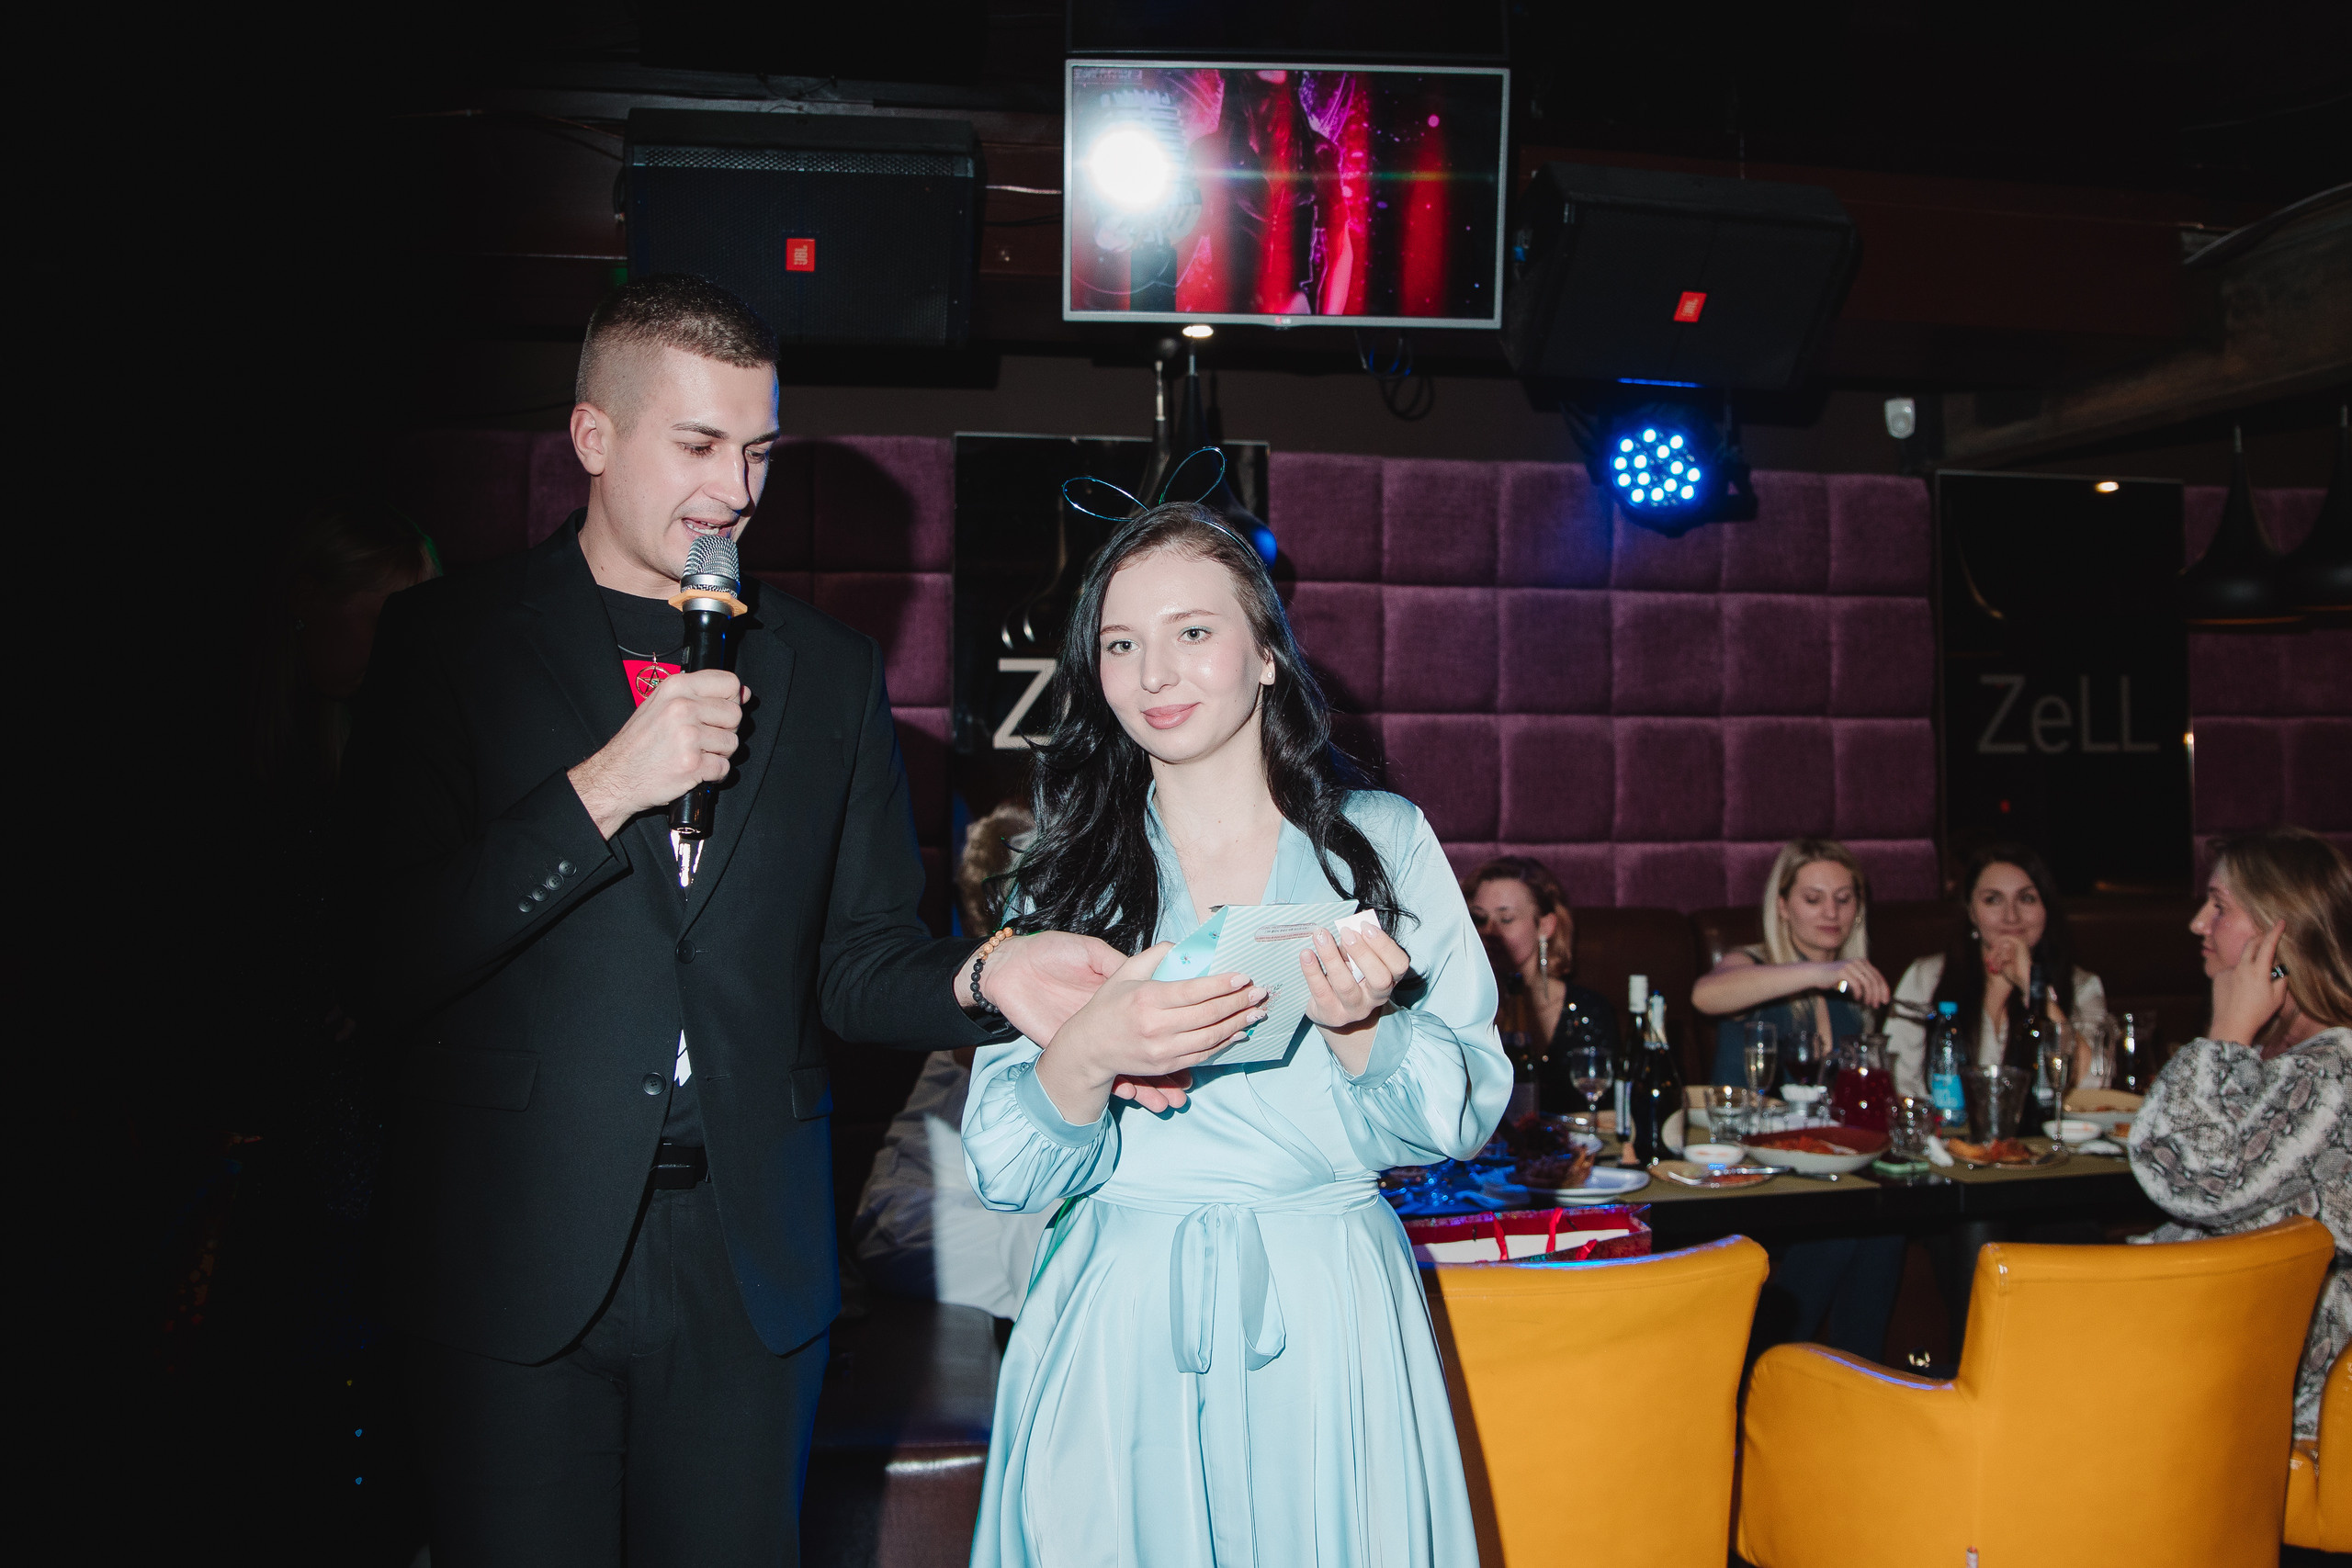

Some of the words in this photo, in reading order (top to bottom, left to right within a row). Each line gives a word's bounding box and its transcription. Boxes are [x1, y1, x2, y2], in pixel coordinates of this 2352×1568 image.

[794, 244, 808, 266] JBL
[992, 657, 1057, 750] Z
[1977, 672, 2162, 754] ZeLL
